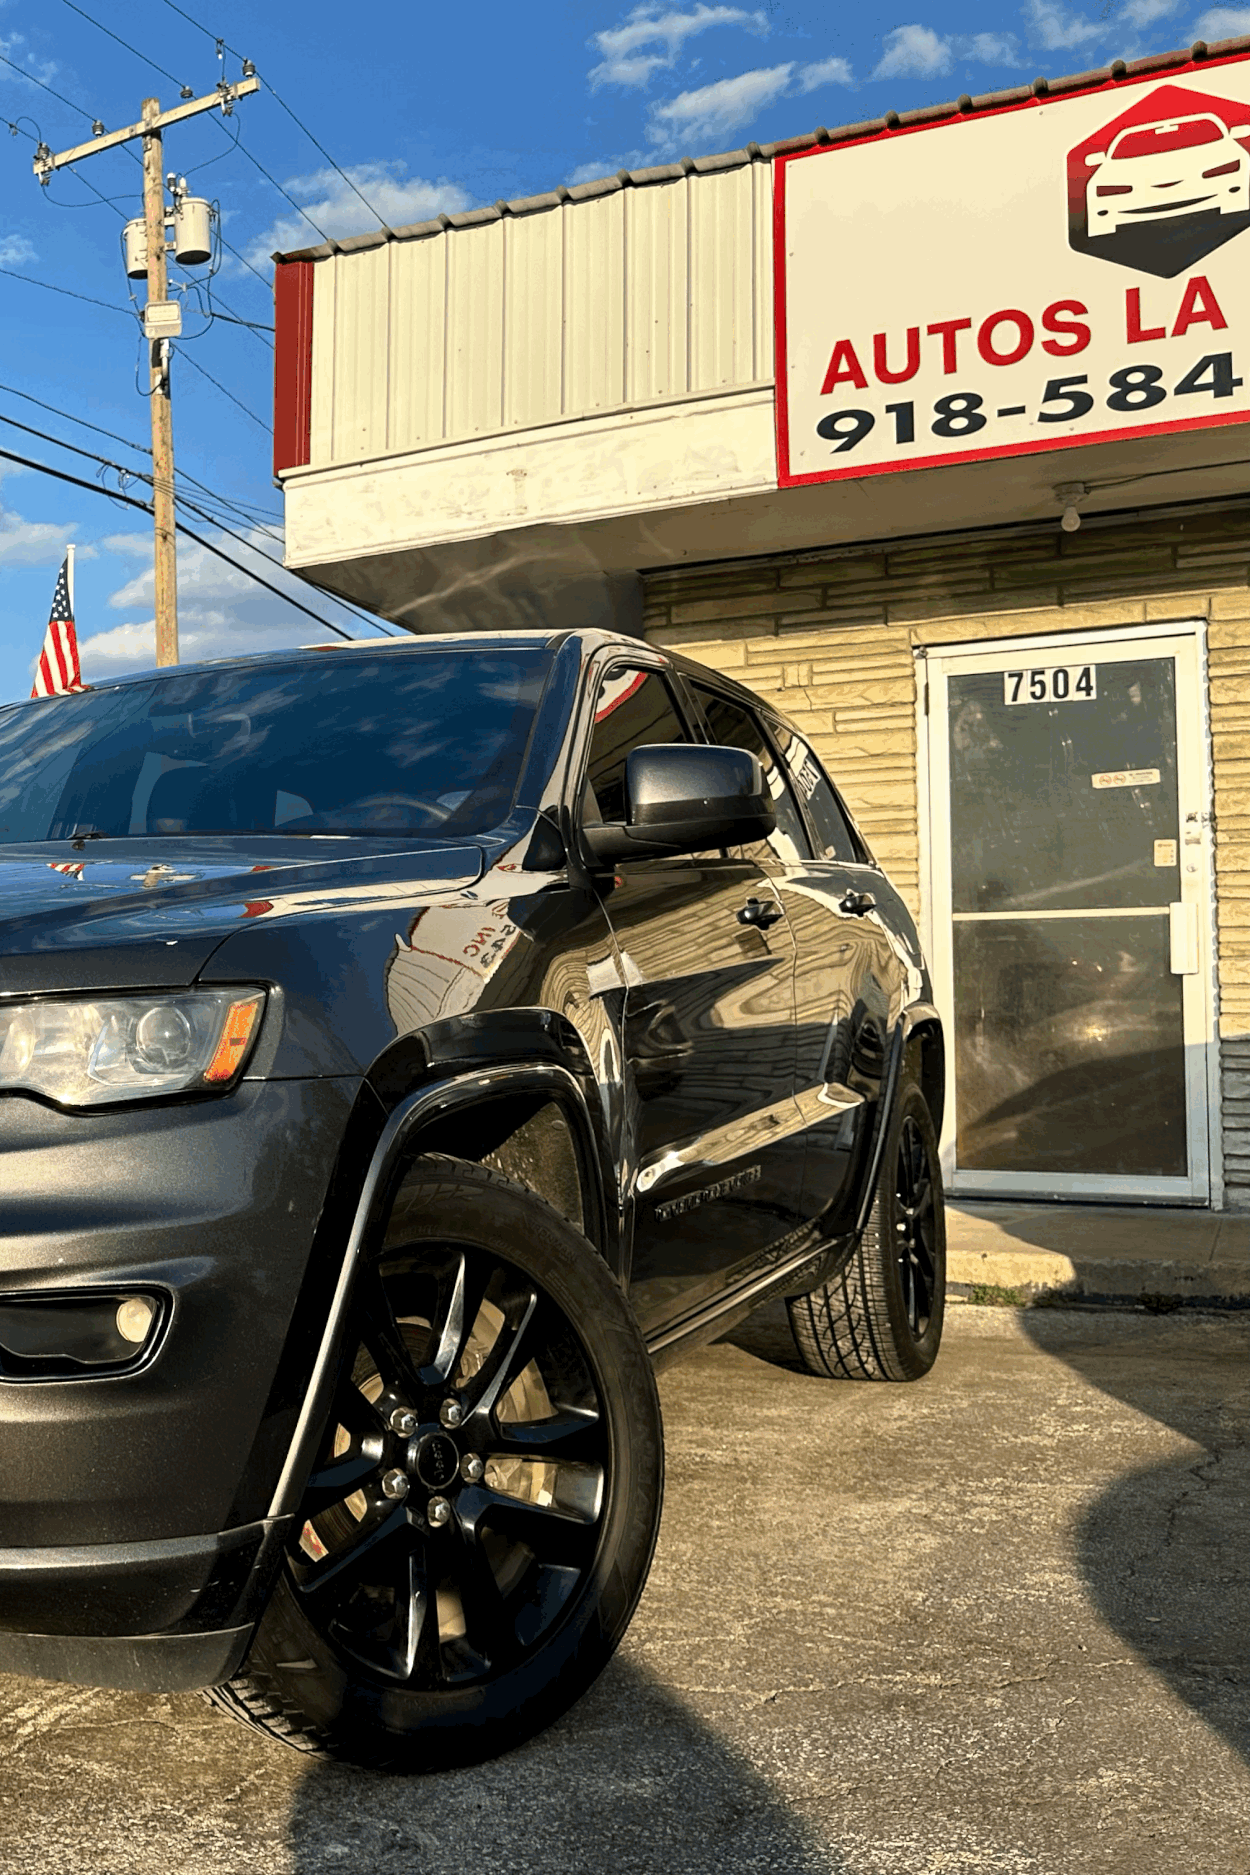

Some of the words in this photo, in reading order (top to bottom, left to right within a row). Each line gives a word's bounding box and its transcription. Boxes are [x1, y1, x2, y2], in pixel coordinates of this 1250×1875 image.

[820, 299, 1091, 396] AUTOS
[1126, 275, 1228, 345] LA
[816, 351, 1243, 454] 918-584
[1007, 667, 1094, 702] 7504
